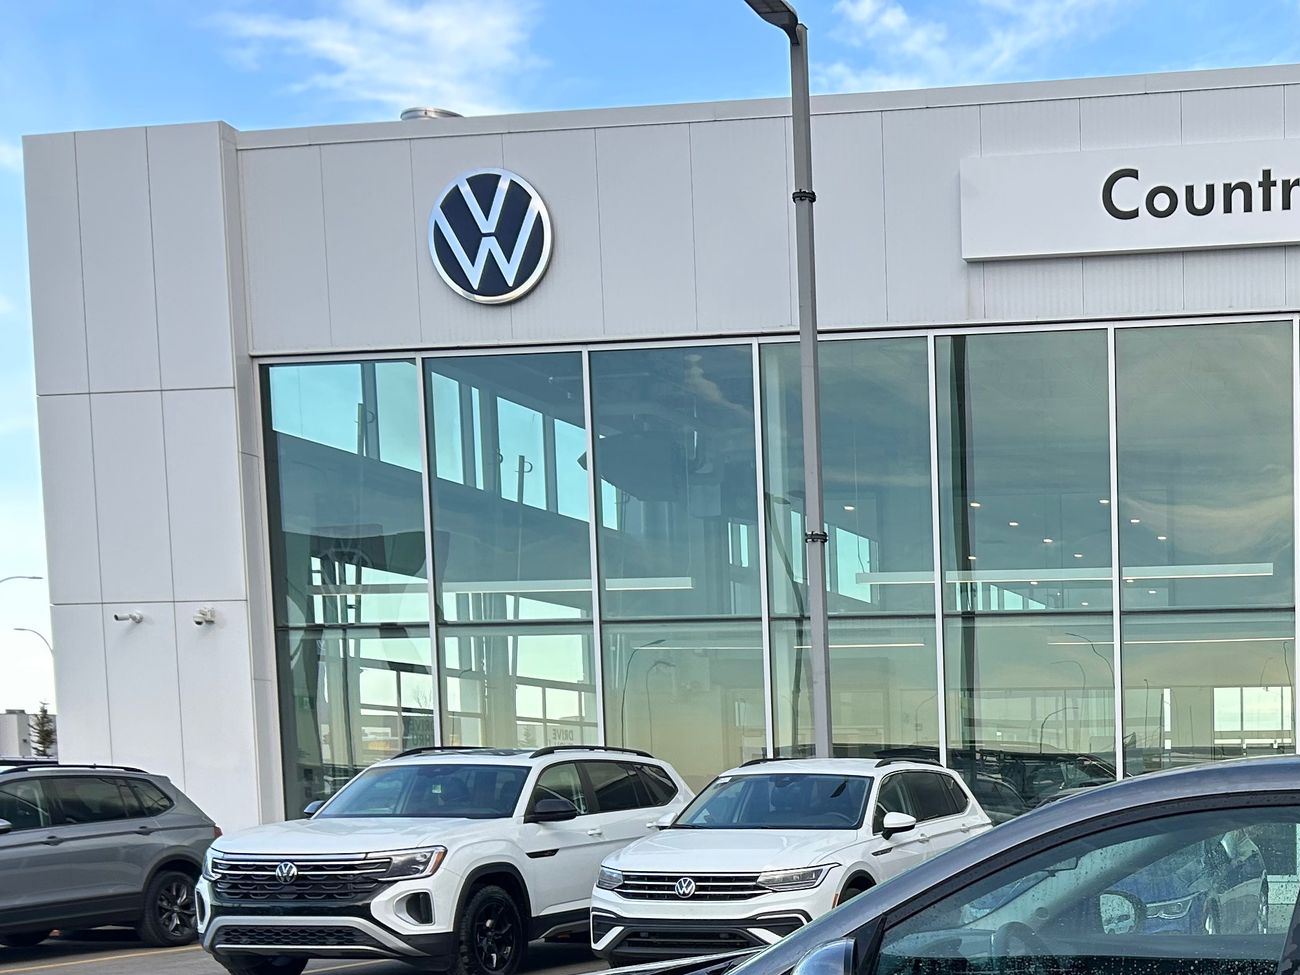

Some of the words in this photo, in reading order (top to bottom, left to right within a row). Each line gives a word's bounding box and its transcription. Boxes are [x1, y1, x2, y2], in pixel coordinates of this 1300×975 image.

[430, 170, 549, 300] VW
[276, 861, 298, 885] VW
[674, 877, 696, 899] VW
